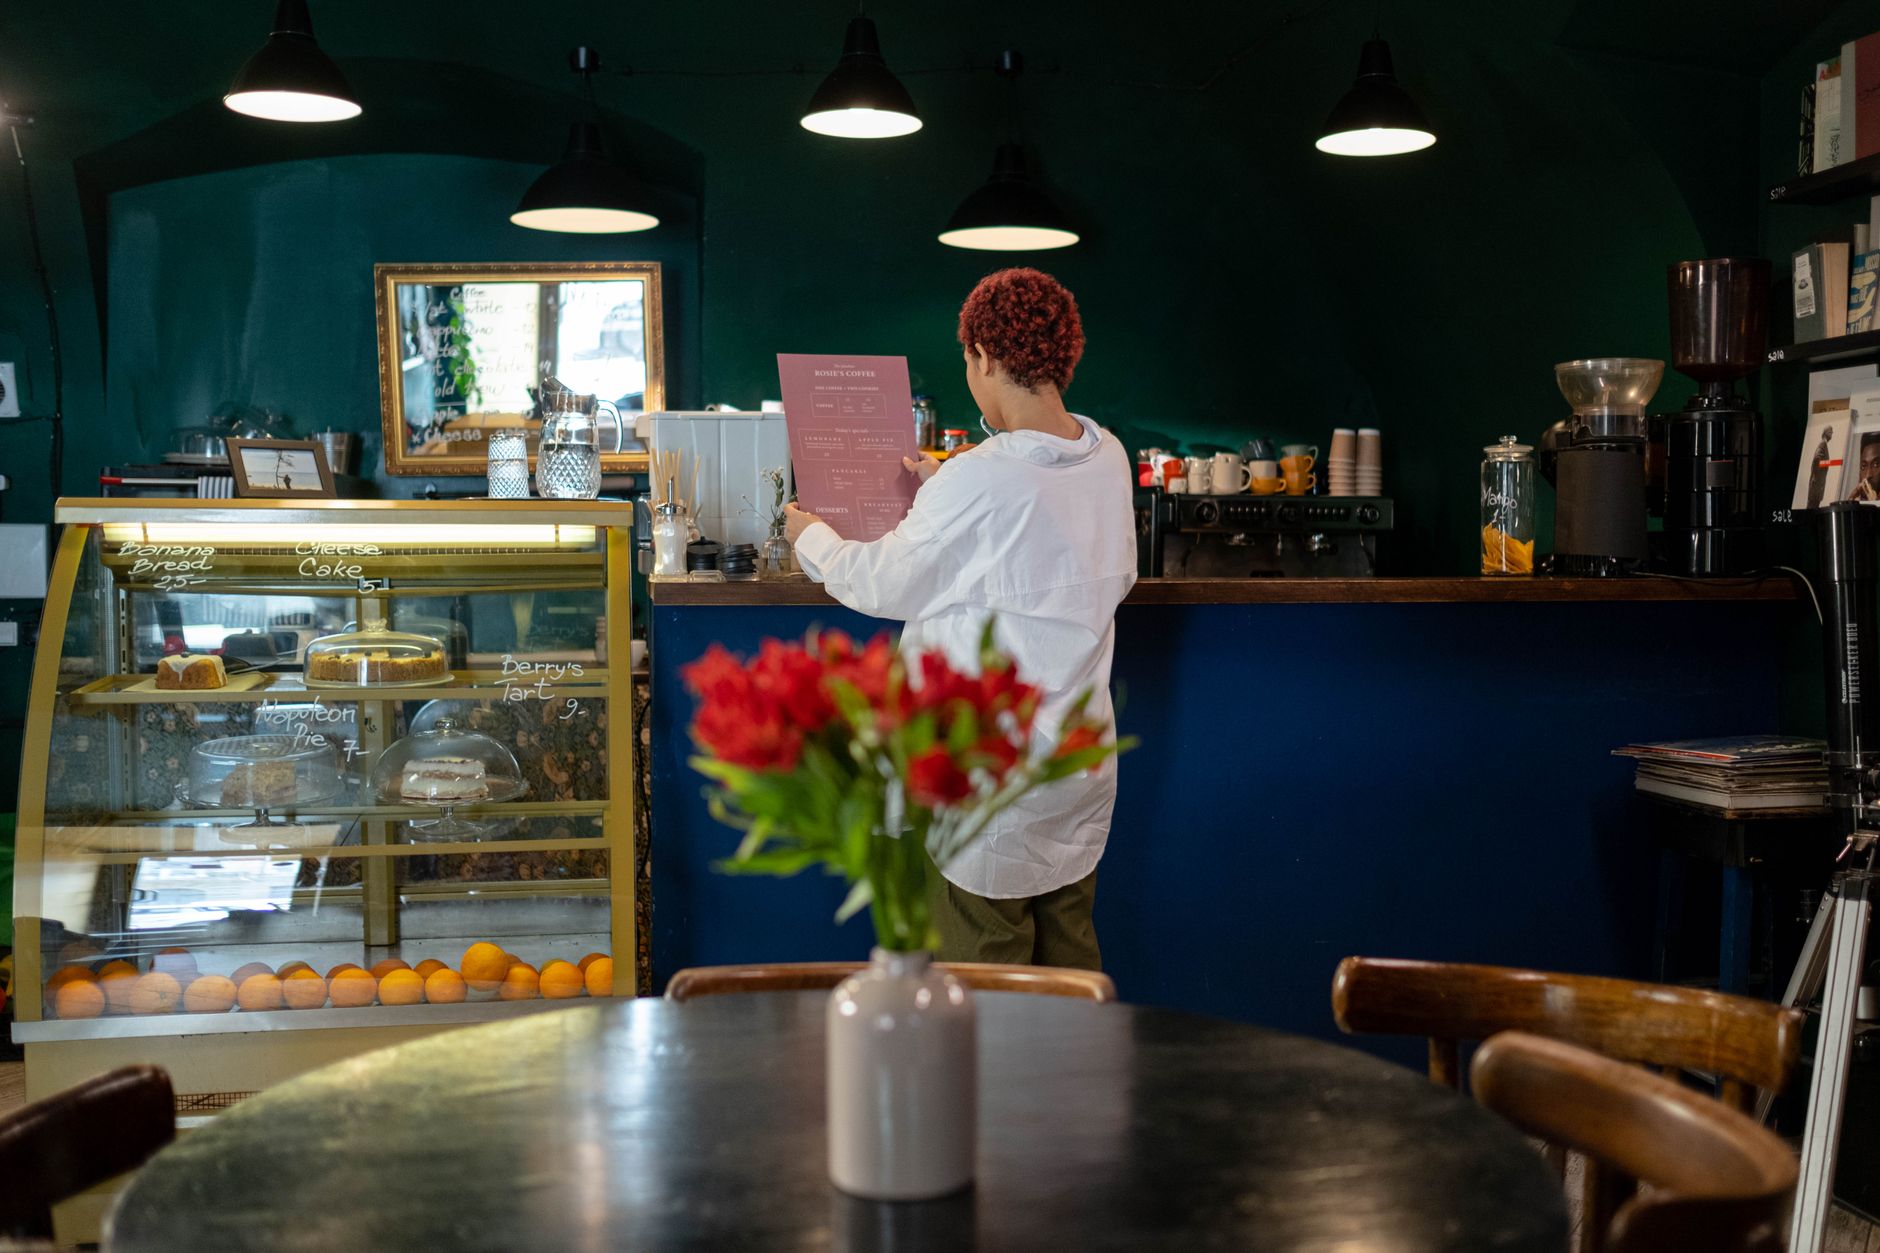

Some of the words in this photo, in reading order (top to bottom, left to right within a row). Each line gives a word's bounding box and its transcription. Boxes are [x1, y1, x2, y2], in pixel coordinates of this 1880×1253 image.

[1768, 350, 1784, 362] sale
[814, 369, 844, 377] ROSIE'S
[1481, 486, 1518, 513] Mango
[1772, 510, 1793, 523] sale
[118, 539, 215, 557] Banana
[295, 541, 383, 556] Cheese
[128, 556, 213, 575] Bread
[298, 557, 365, 579] Cake
[501, 654, 585, 680] Berry's
[494, 678, 556, 702] Tart
[255, 695, 356, 724] Napoleon
[293, 722, 328, 748] Pie
